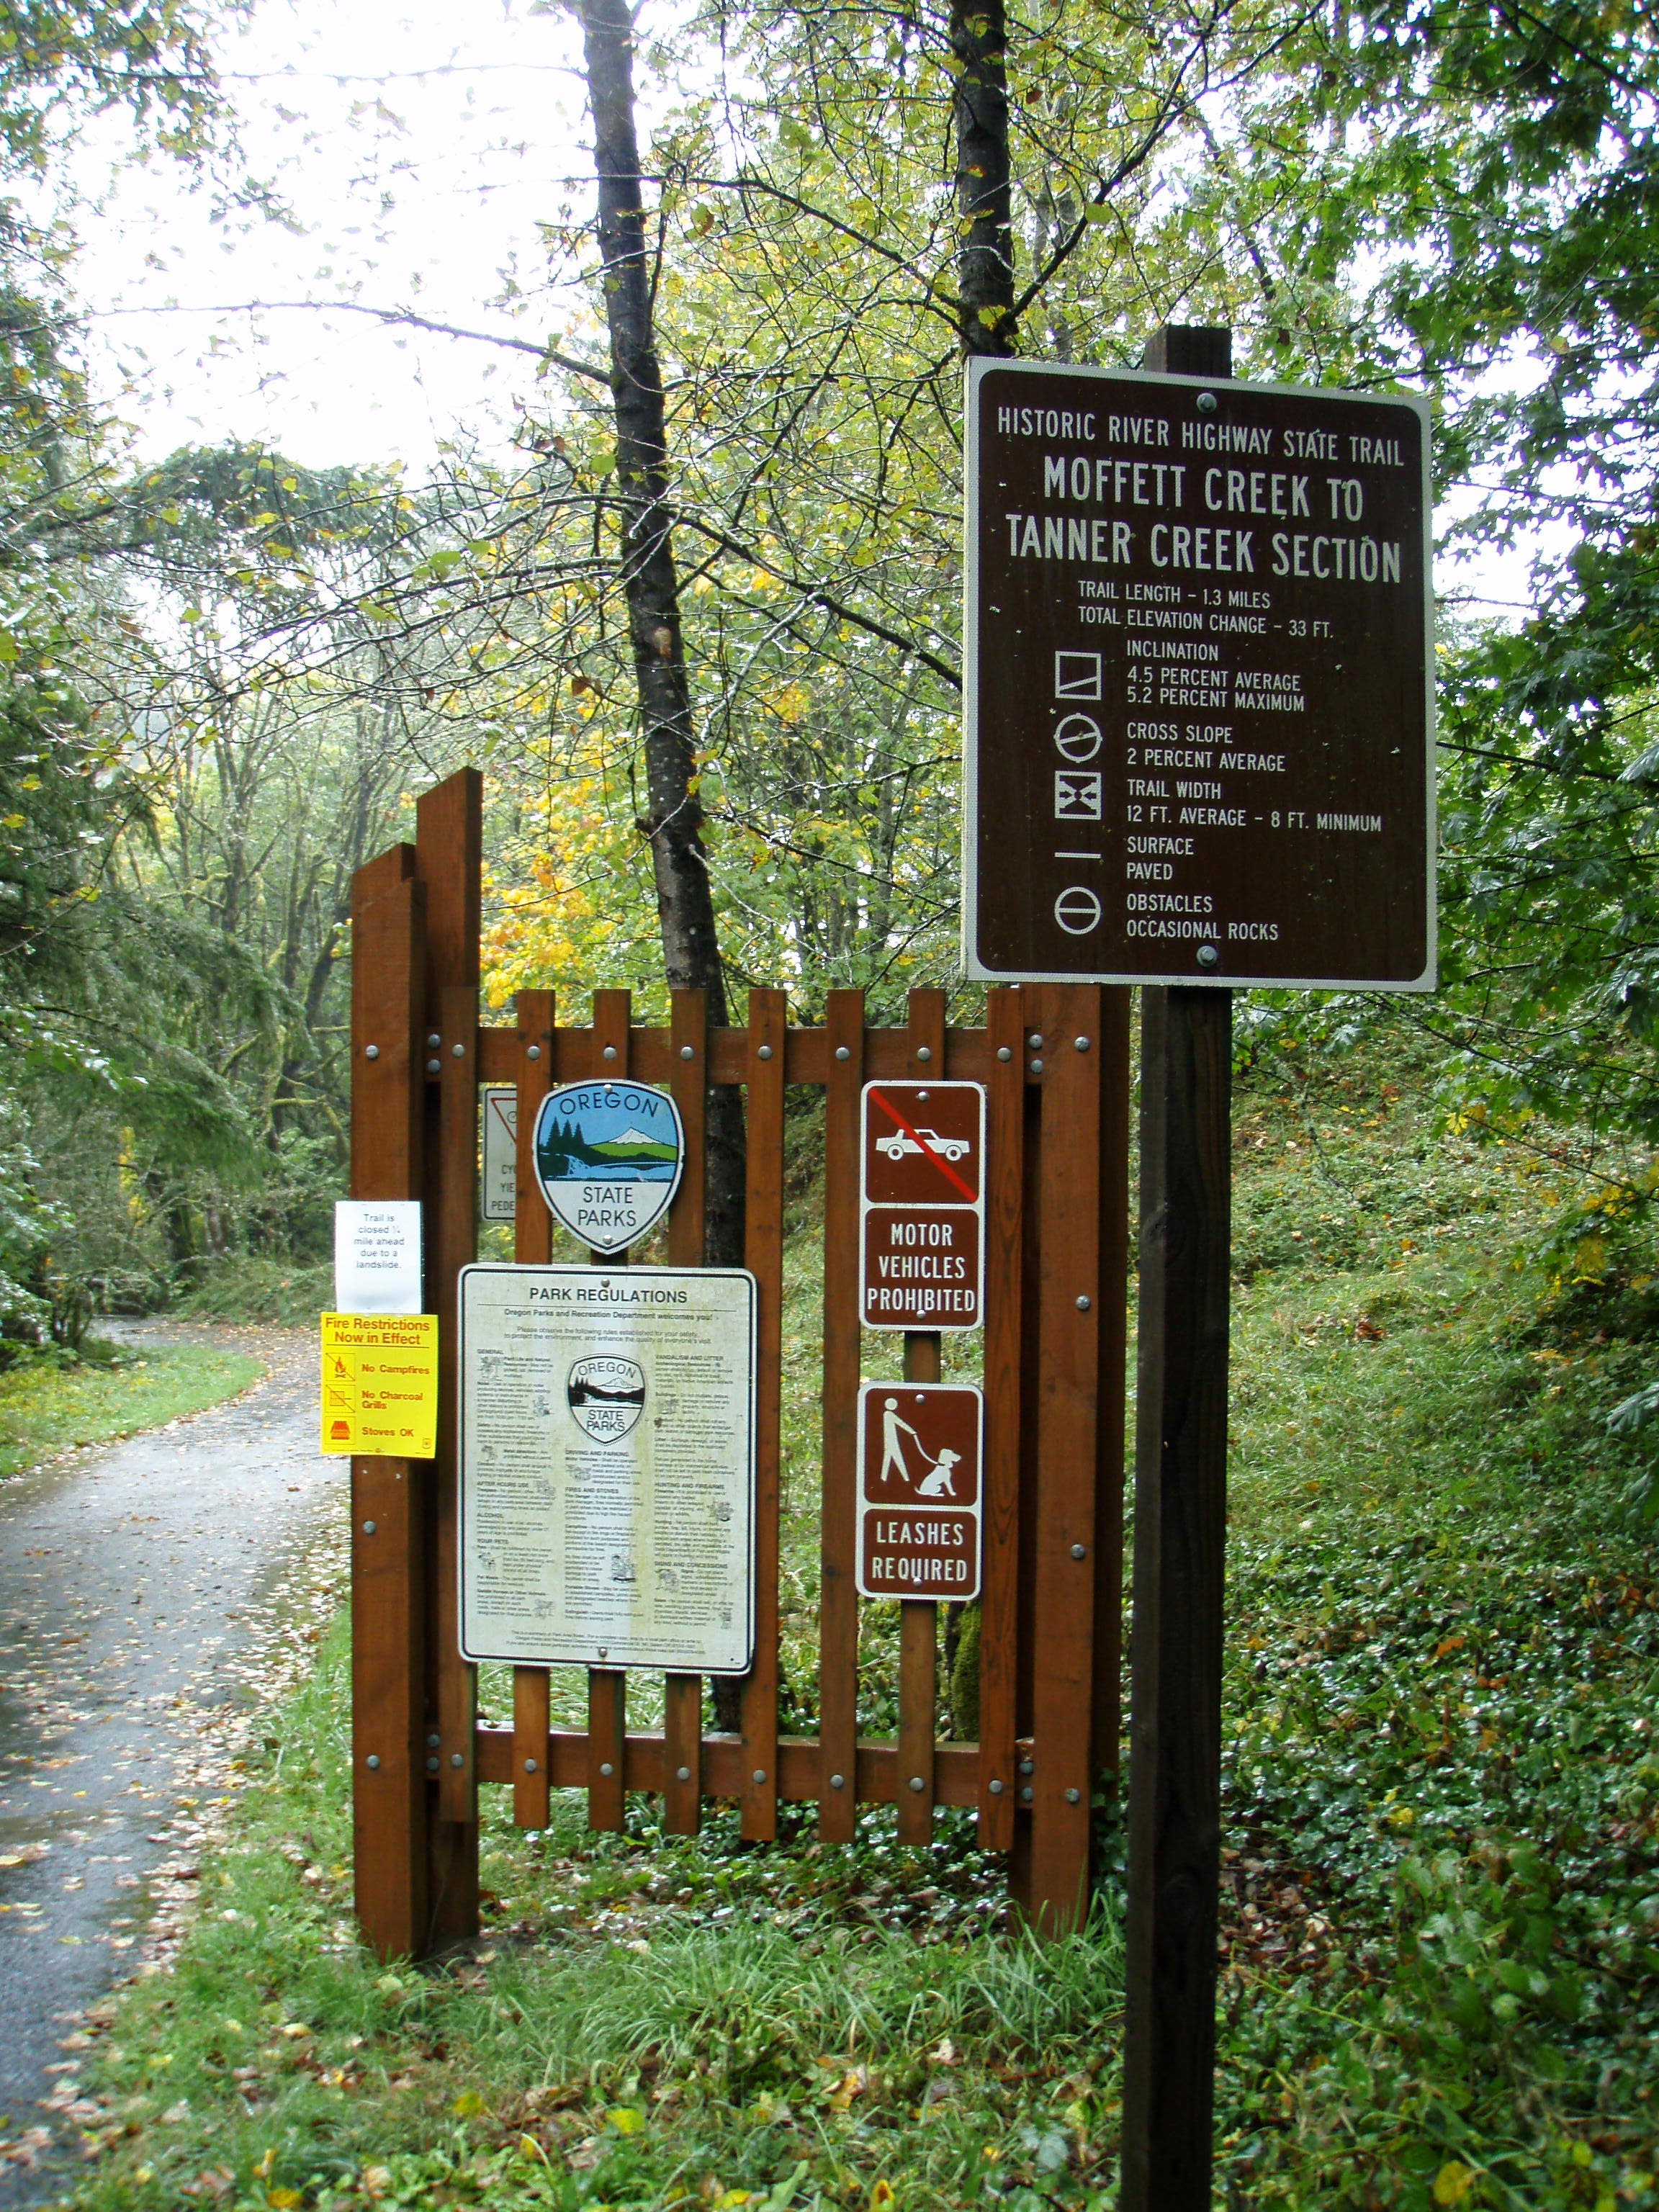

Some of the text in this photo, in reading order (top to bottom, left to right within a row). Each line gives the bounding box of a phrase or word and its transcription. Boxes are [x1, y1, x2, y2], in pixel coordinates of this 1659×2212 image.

[998, 407, 1404, 466] HISTORIC RIVER HIGHWAY STATE TRAIL
[1044, 456, 1363, 522] MOFFETT CREEK TO
[1005, 513, 1401, 583] TANNER CREEK SECTION
[1079, 580, 1119, 599] TRAIL
[1125, 584, 1181, 603] LENGTH
[1203, 589, 1221, 606] 1.3
[1228, 591, 1270, 609] MILES
[1079, 606, 1120, 624] TOTAL
[1128, 609, 1202, 630] ELEVATION
[1210, 615, 1266, 634] CHANGE
[1289, 620, 1306, 636] 33
[1313, 621, 1334, 639] FT.
[1127, 639, 1218, 661] INCLINATION
[1127, 666, 1300, 691] 4.5 PERCENT AVERAGE
[1127, 686, 1304, 711] 5.2 PERCENT MAXIMUM
[1127, 722, 1233, 744] CROSS SLOPE
[1127, 749, 1285, 771] 2 PERCENT AVERAGE
[1127, 779, 1221, 799] TRAIL WIDTH
[1127, 806, 1143, 822] 12
[1151, 806, 1172, 824] FT.
[1179, 808, 1246, 827] AVERAGE
[1271, 811, 1280, 827] 8
[1288, 813, 1309, 829] FT.
[1317, 814, 1381, 832] MINIMUM
[1127, 837, 1194, 855] SURFACE
[1127, 863, 1173, 881] PAVED
[1127, 894, 1213, 914] OBSTACLES
[1127, 920, 1278, 941] OCCASIONAL ROCKS
[559, 1092, 658, 1118] OREGON
[583, 1187, 633, 1204] STATE
[577, 1210, 637, 1226] PARKS
[377, 1237, 405, 1246] ahead
[890, 1223, 953, 1246] MOTOR
[878, 1256, 966, 1280] VEHICLES
[530, 1287, 687, 1303] PARK REGULATIONS
[868, 1287, 975, 1312] PROHIBITED
[325, 1318, 430, 1331] Fire Restrictions
[505, 1308, 531, 1317] Oregon
[613, 1312, 656, 1321] Department
[335, 1331, 421, 1345] Now in Effect
[361, 1364, 430, 1375] No Campfires
[577, 1362, 636, 1378] OREGON
[361, 1390, 423, 1401] No Charcoal
[362, 1401, 387, 1410] Grills
[589, 1410, 624, 1421] STATE
[361, 1426, 414, 1437] Stoves OK
[587, 1421, 625, 1431] PARKS
[876, 1521, 964, 1546] LEASHES
[872, 1556, 967, 1581] REQUIRED
